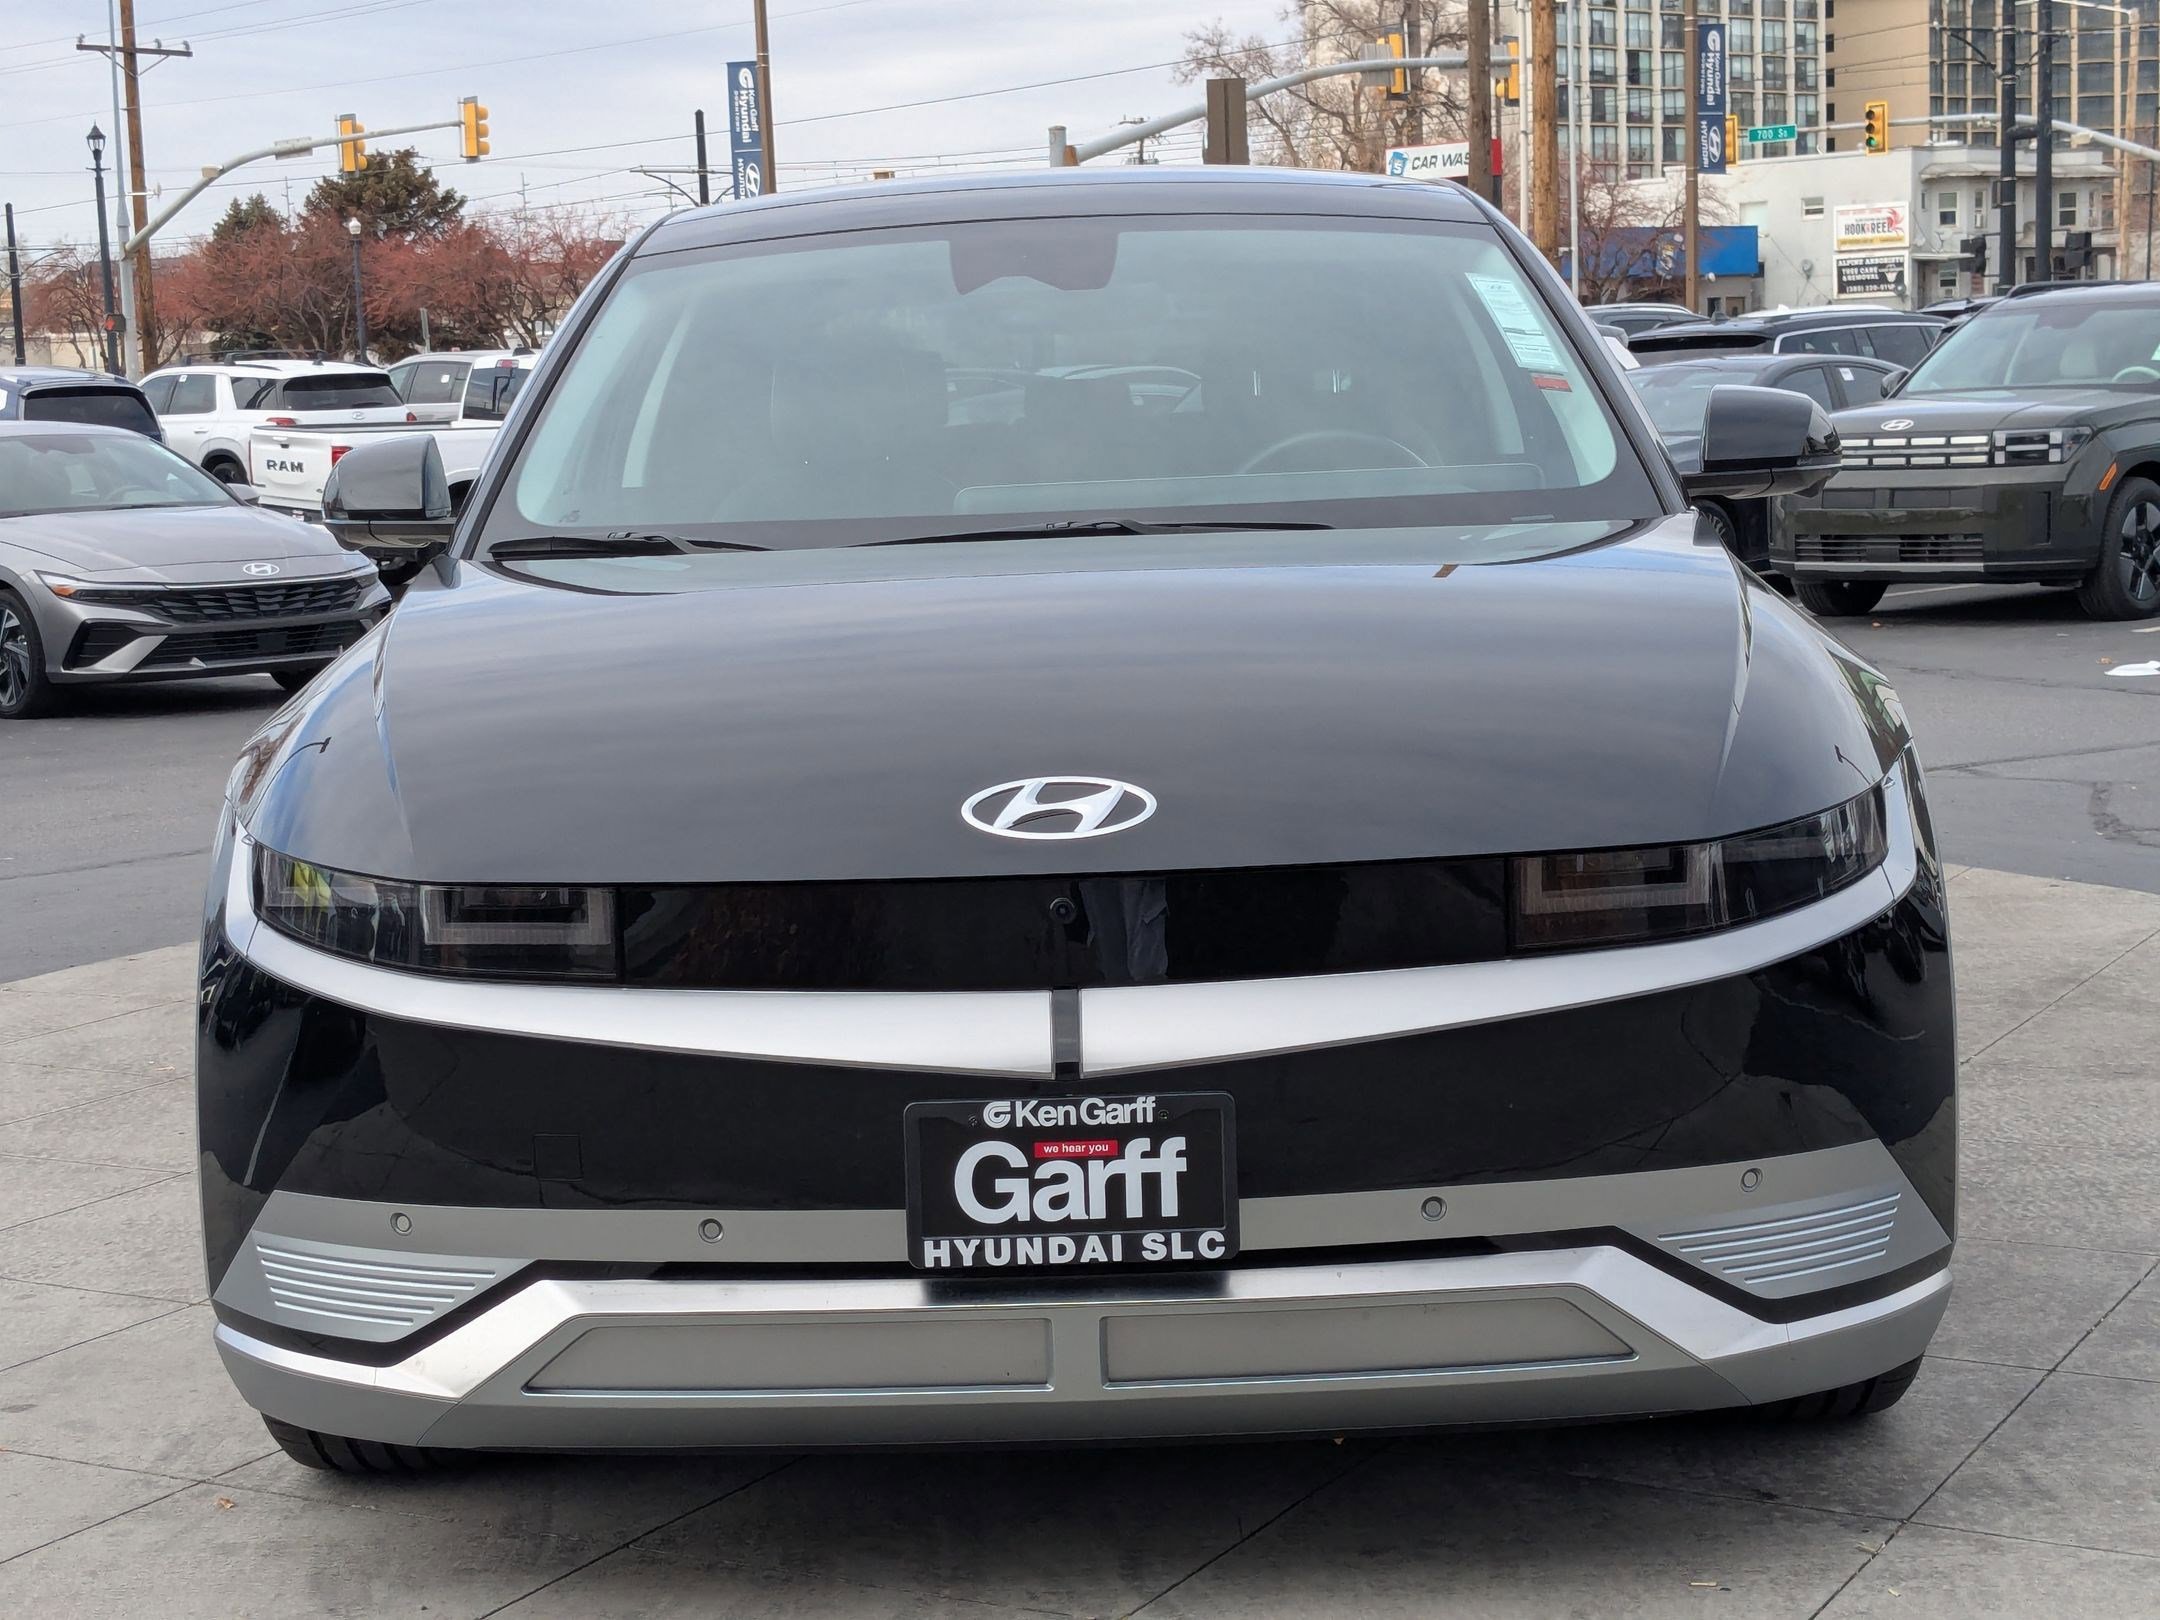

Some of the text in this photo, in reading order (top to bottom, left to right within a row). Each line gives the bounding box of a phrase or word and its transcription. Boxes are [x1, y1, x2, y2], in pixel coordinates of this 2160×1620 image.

[1707, 52, 1715, 105] Hyundai
[739, 89, 752, 143] Hyundai
[750, 109, 759, 131] Garff
[1757, 129, 1773, 140] 700
[1412, 155, 1438, 170] CAR
[1442, 151, 1470, 167] WAS
[1844, 223, 1866, 235] HOOK
[1871, 221, 1892, 234] REEL
[1860, 266, 1877, 274] CARE
[266, 459, 304, 473] RAM
[1015, 1096, 1156, 1128] Ken Garff
[1043, 1143, 1109, 1155] we hear you
[954, 1136, 1188, 1225] Garff
[922, 1230, 1226, 1268] HYUNDAI SLC
